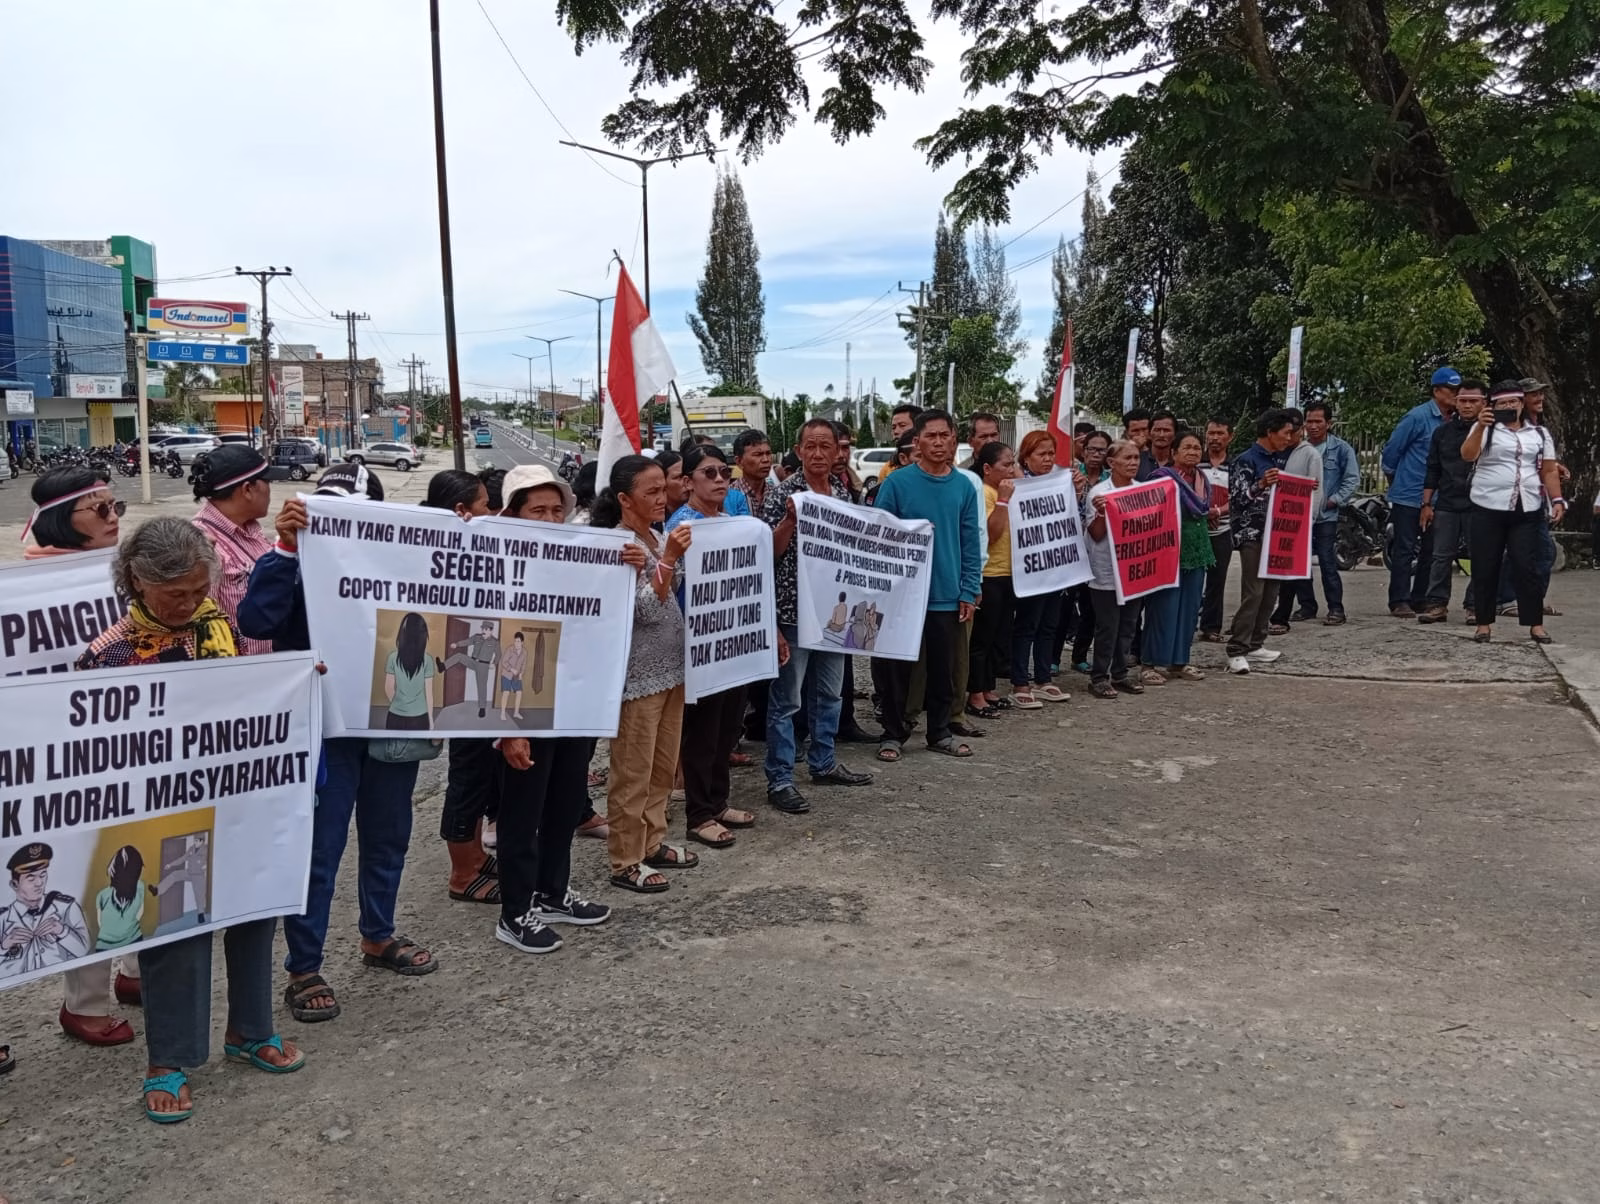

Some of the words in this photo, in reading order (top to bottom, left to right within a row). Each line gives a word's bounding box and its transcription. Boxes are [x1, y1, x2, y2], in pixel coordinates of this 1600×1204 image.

[1019, 493, 1066, 520] PANGULU
[1114, 487, 1167, 514] TURUNKAN
[799, 519, 816, 537] TIDAK
[816, 524, 832, 542] MAU
[801, 501, 819, 519] KAMI
[820, 504, 865, 533] MASYARAKAT
[1017, 525, 1045, 549] KAMI
[1046, 517, 1078, 543] DOYAN
[1122, 510, 1164, 537] PANGULU
[311, 516, 351, 538] KAMI
[357, 521, 394, 543] YANG
[398, 525, 466, 552] MEMILIH,
[471, 535, 500, 555] KAMI
[504, 539, 538, 560] YANG
[542, 543, 624, 566] MENURUNKAN
[1114, 530, 1175, 561] ERKELAKUAN
[430, 551, 505, 585] SEGERA
[511, 560, 526, 587] !!
[701, 549, 728, 575] KAMI
[731, 544, 757, 570] TIDAK
[802, 540, 843, 564] KELUARKAN
[852, 554, 904, 576] PEMBERHENTIAN
[1024, 543, 1080, 575] SELINGKUH
[1128, 558, 1157, 582] BEJAT
[691, 580, 717, 607] MAU
[720, 573, 762, 602] DIPIMPIN
[835, 568, 842, 582] &
[843, 570, 867, 588] PROSES
[868, 576, 892, 592] HUKUM
[339, 576, 392, 602] COPOT
[397, 582, 470, 608] PANGULU
[474, 588, 505, 610] DARI
[509, 592, 601, 617] JABATANNYA
[689, 607, 735, 637] PANGULU
[737, 602, 761, 628] YANG
[690, 642, 711, 668] DAK
[715, 629, 770, 666] BERMORAL
[69, 685, 141, 727] STOP
[149, 682, 166, 717] !!
[0, 746, 35, 788] AN
[46, 728, 172, 781] LINDUNGI
[182, 711, 290, 759] PANGULU
[2, 799, 22, 838] K
[33, 782, 135, 833] MORAL
[145, 751, 309, 811] MASYARAKAT
